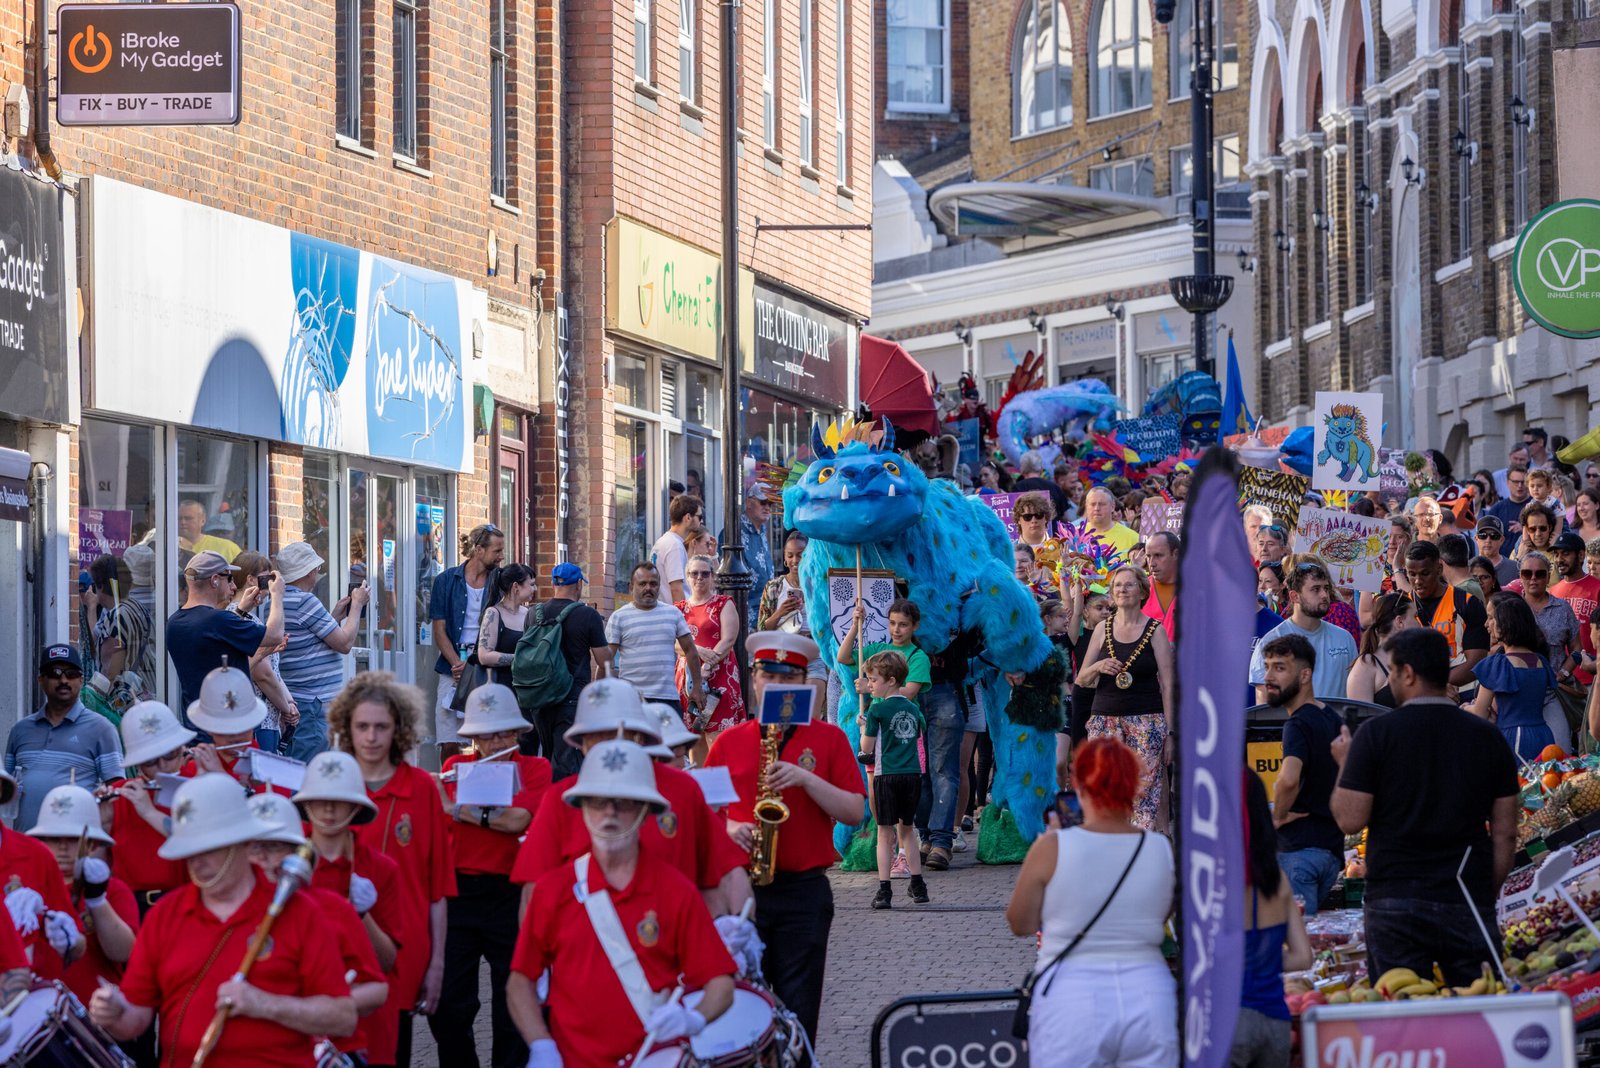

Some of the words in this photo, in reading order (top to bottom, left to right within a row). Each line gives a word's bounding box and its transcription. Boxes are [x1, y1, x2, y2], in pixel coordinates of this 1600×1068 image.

[121, 31, 180, 49] iBroke
[121, 52, 149, 72] My
[152, 51, 224, 72] Gadget
[79, 98, 102, 111] FIX
[117, 98, 148, 111] BUY
[163, 97, 213, 110] TRADE
[0, 238, 44, 311] Gadget
[663, 260, 702, 328] Chennai
[1547, 291, 1575, 299] INHALE
[1576, 291, 1591, 299] THE
[0, 318, 25, 351] TRADE
[757, 298, 775, 341] THE
[776, 306, 813, 356] CUTTING
[812, 320, 830, 362] BAR
[557, 306, 569, 519] EXCITING
[1244, 484, 1302, 503] CHINEHAM
[901, 1041, 1018, 1068] COCO
